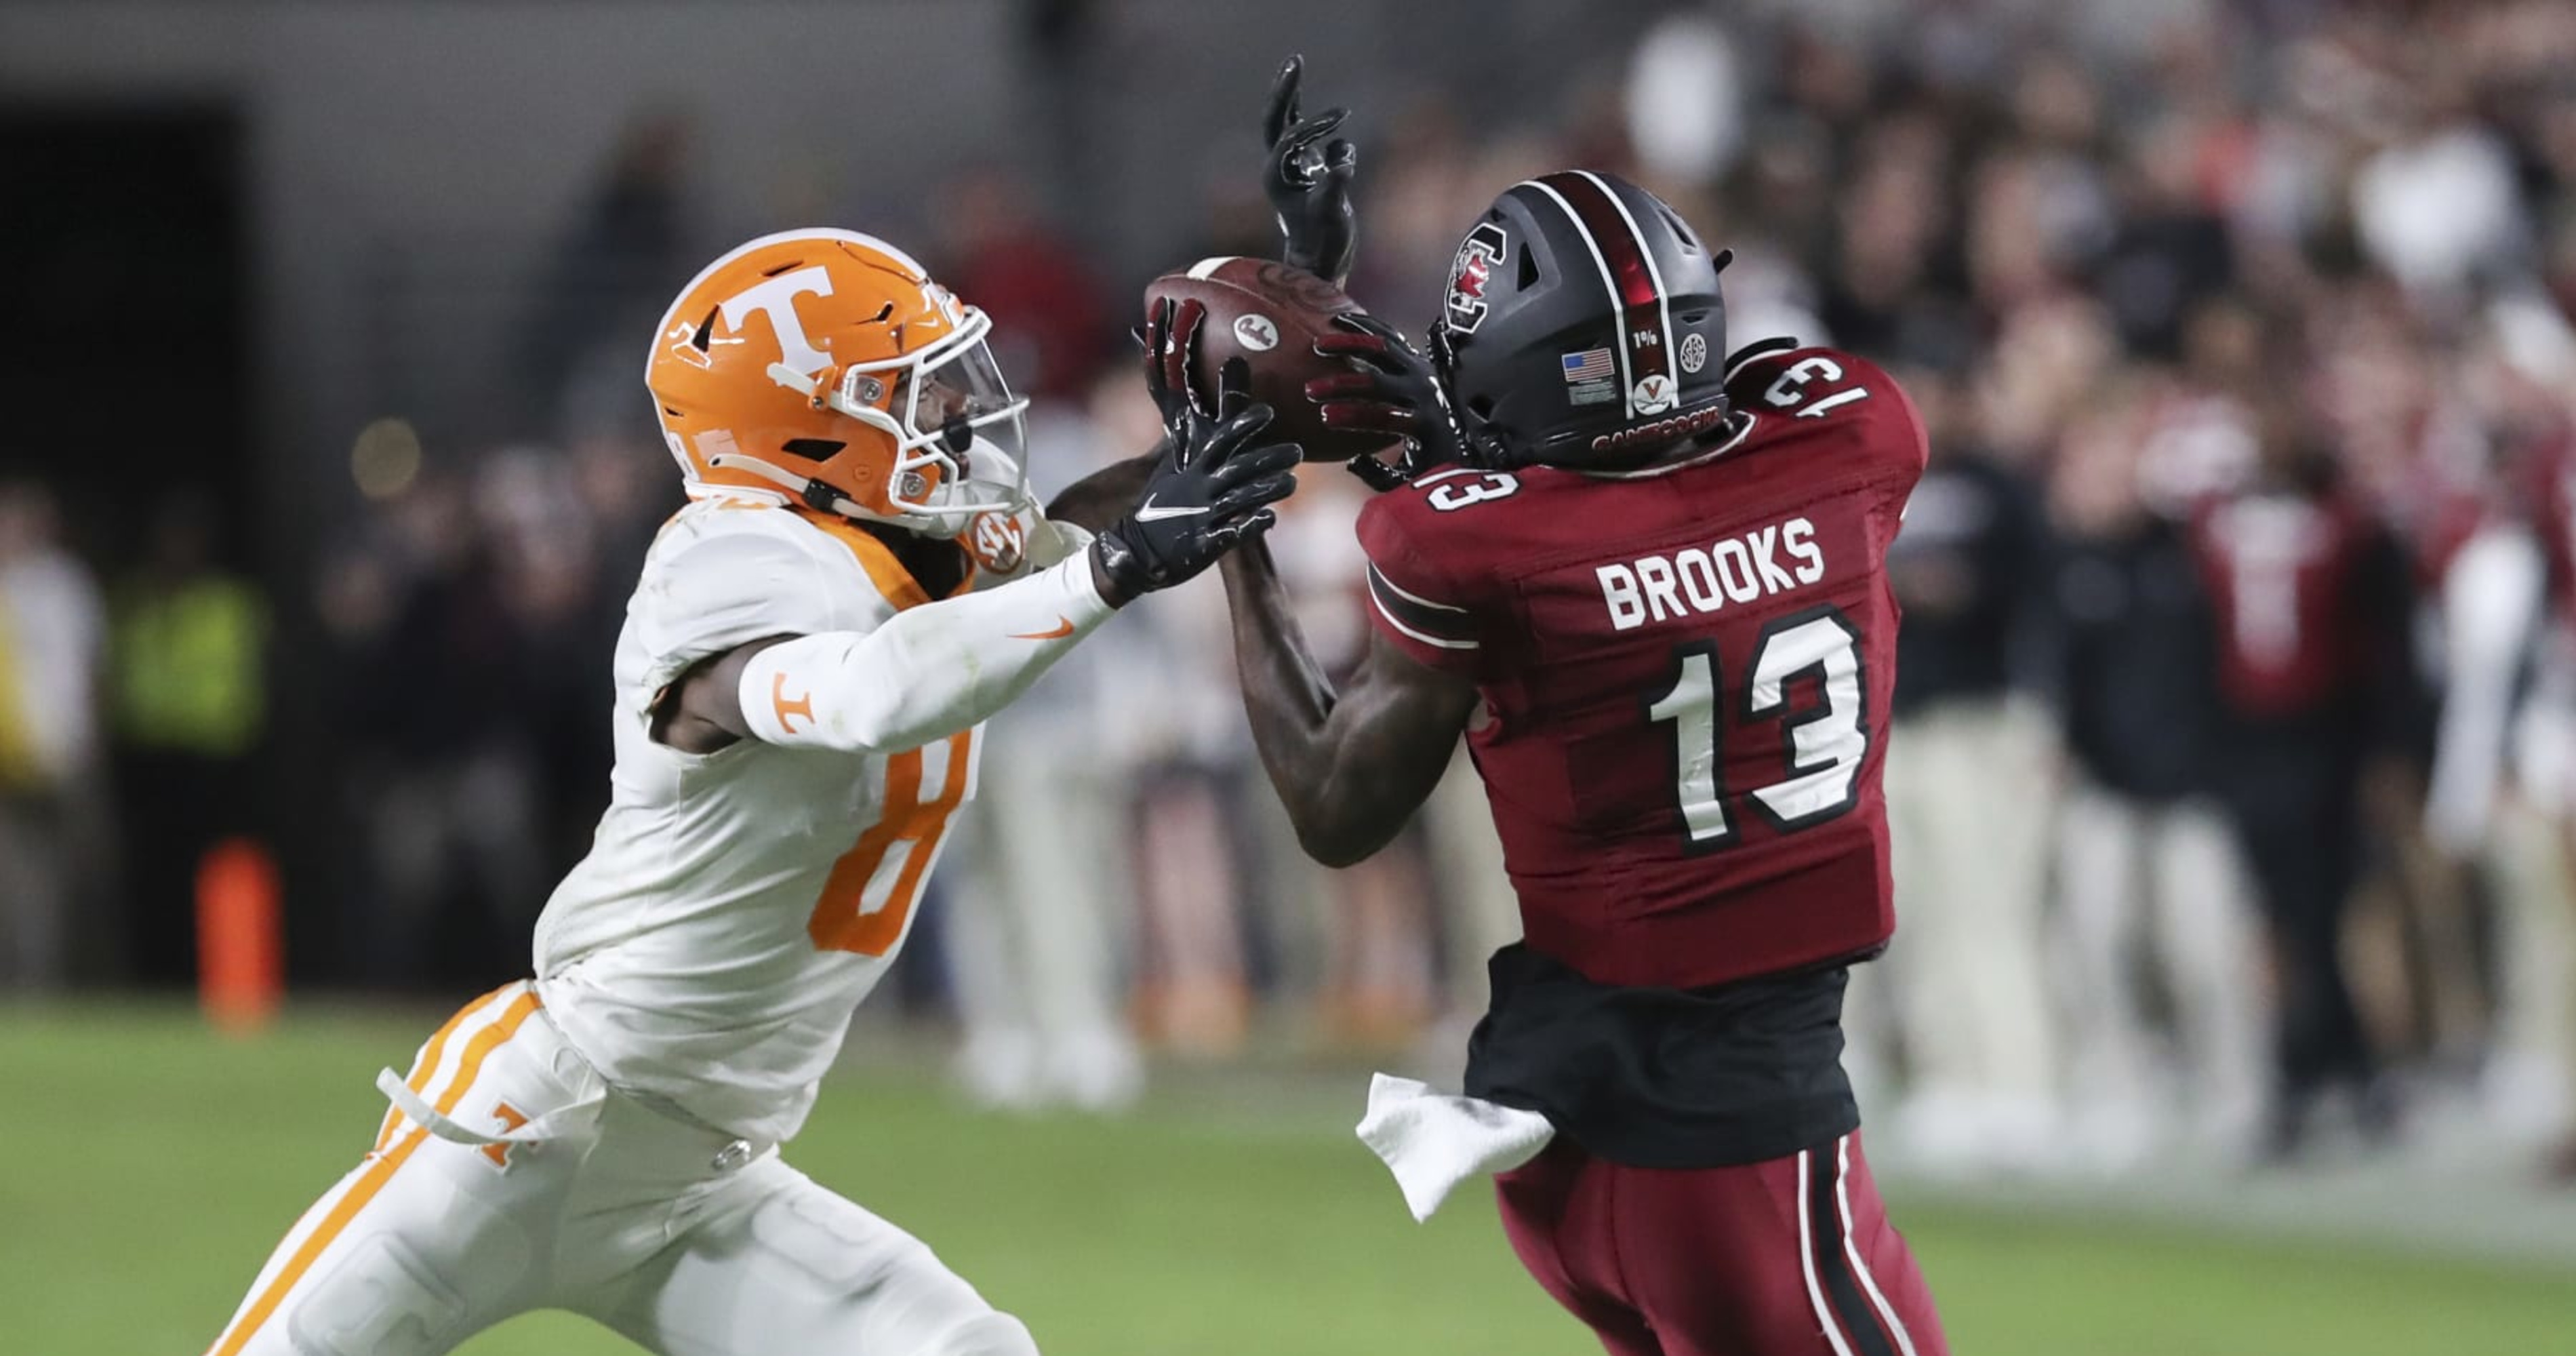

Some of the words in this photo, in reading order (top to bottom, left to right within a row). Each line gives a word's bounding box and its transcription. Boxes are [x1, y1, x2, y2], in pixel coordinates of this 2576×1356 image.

[721, 265, 835, 375] T
[1633, 330, 1658, 348] 1%
[1642, 378, 1662, 400] V
[1763, 357, 1868, 418] 13
[1595, 517, 1825, 631] BROOKS
[773, 672, 816, 735] T
[1648, 613, 1868, 845] 13
[807, 728, 976, 957] 8
